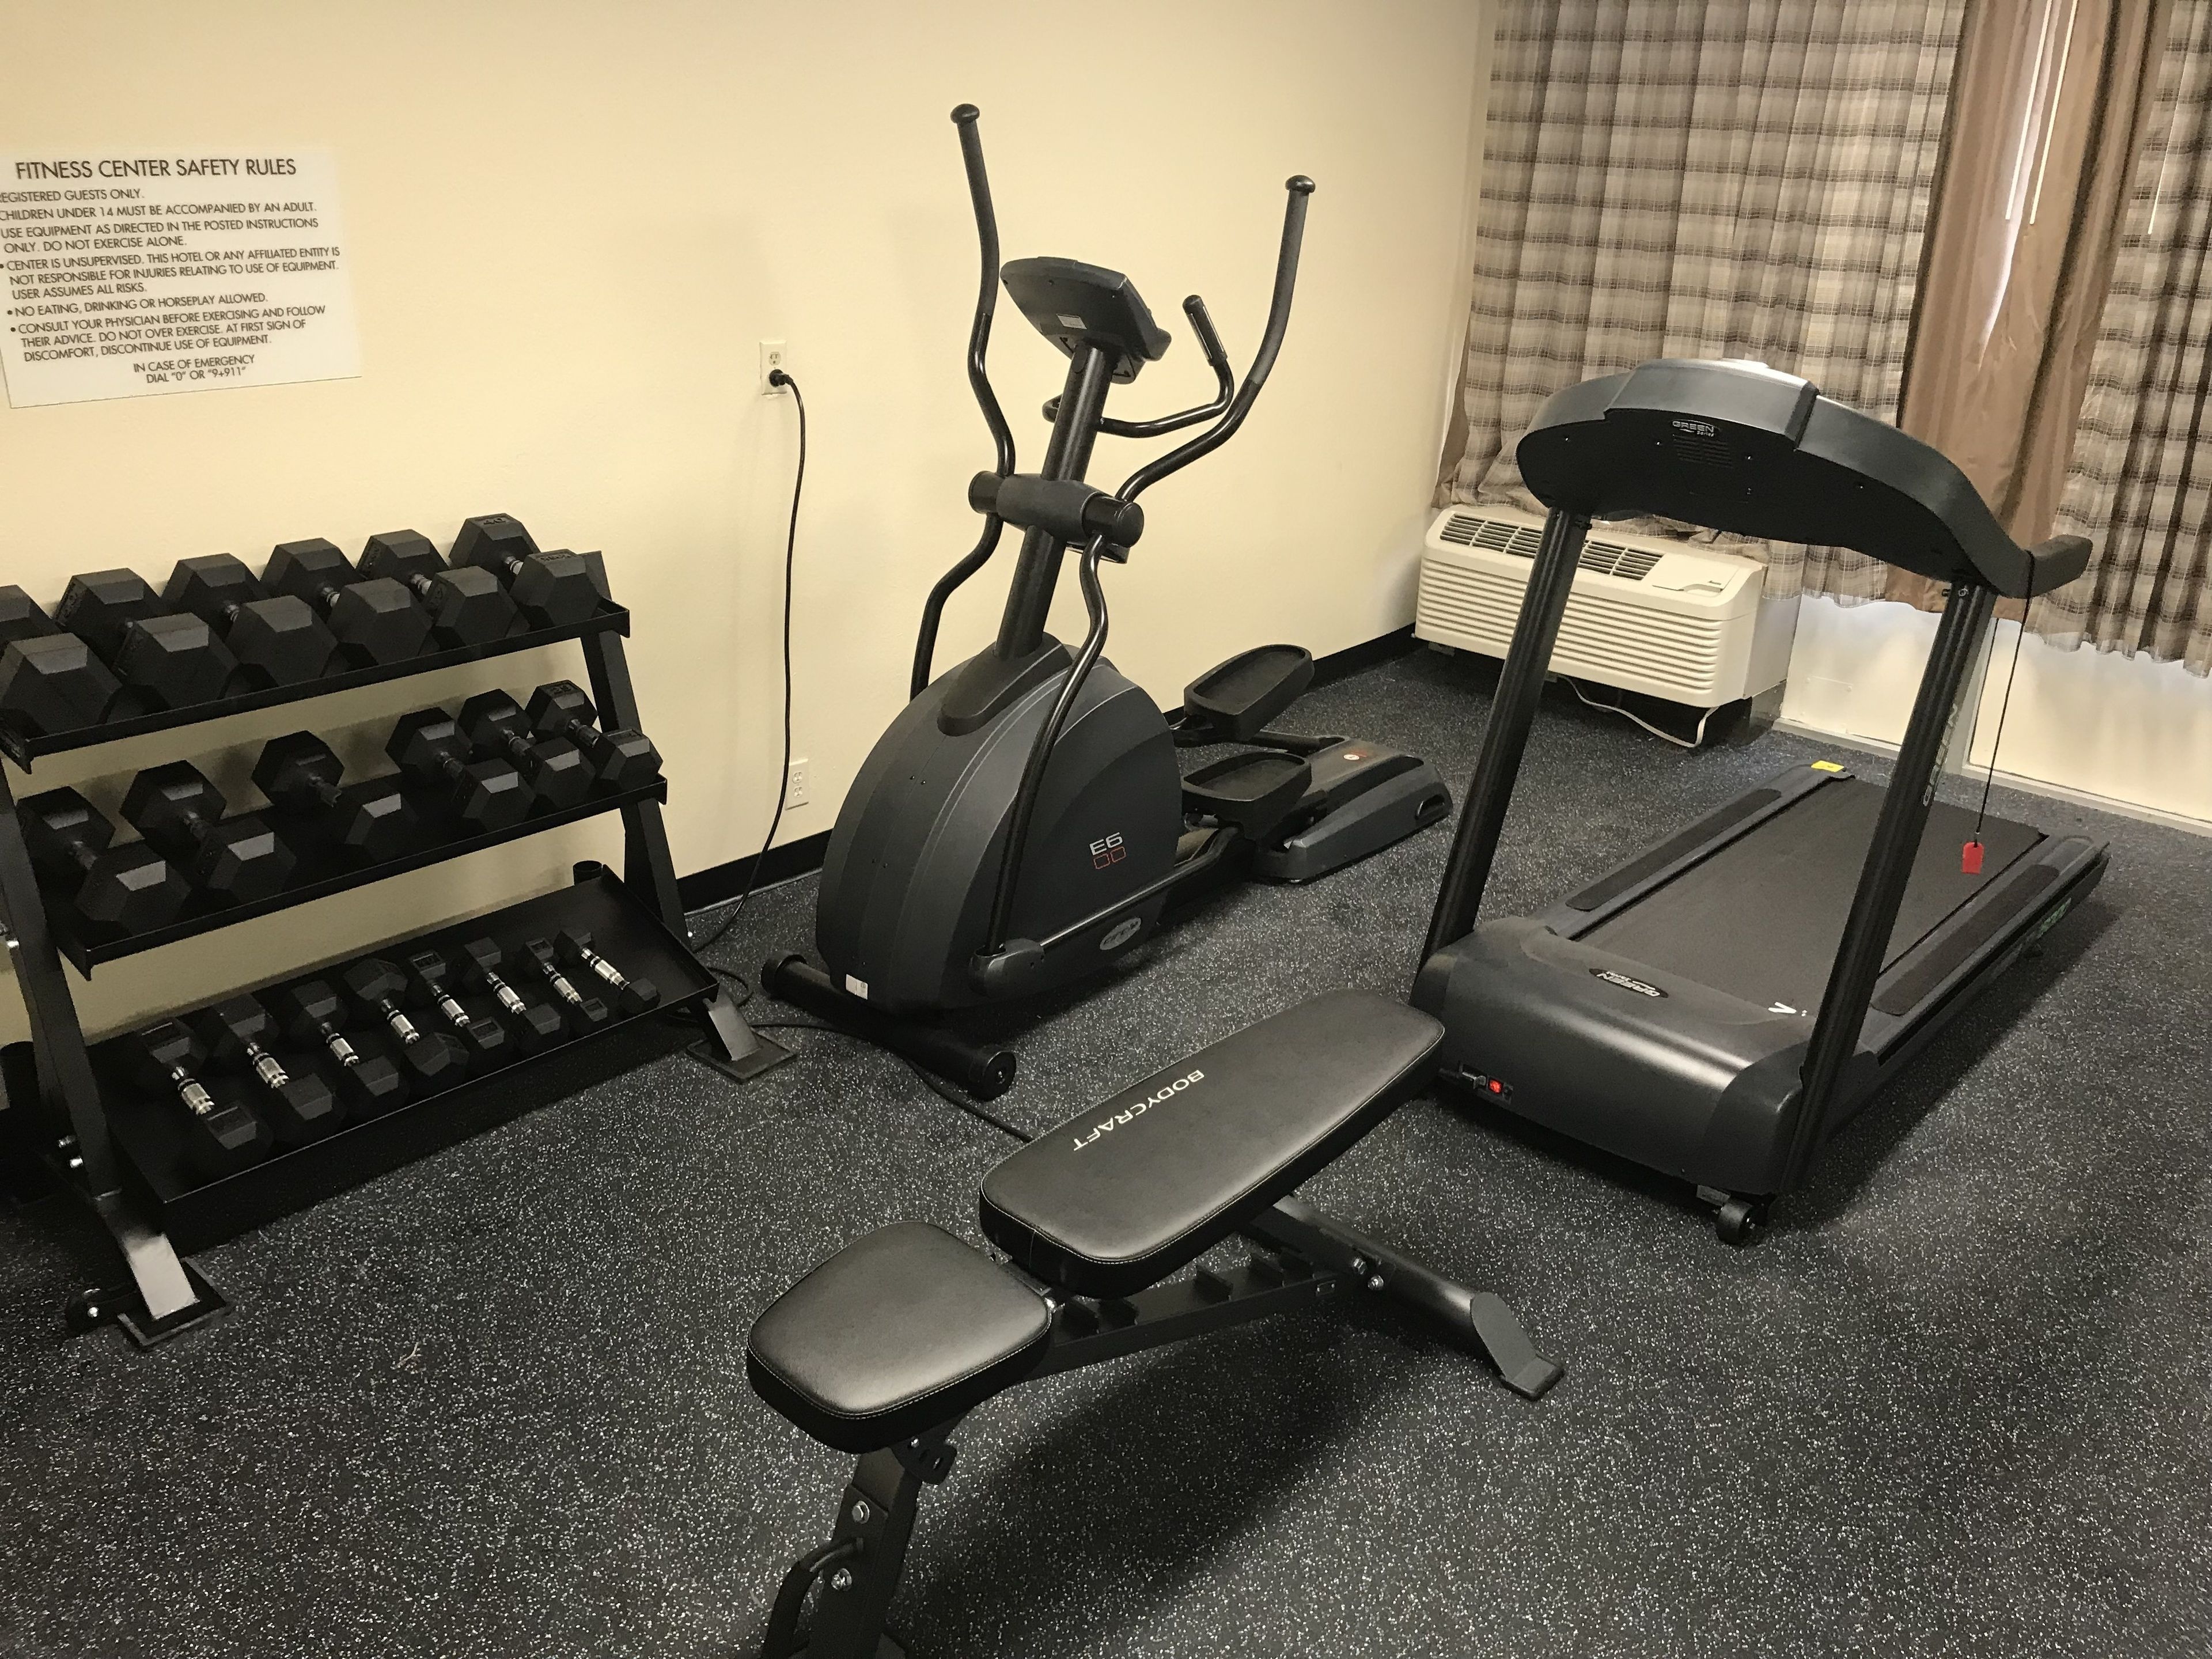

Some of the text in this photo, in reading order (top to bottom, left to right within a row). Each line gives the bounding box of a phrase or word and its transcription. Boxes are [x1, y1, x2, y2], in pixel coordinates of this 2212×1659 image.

[16, 158, 296, 179] FITNESS CENTER SAFETY RULES
[65, 190, 107, 200] GUESTS
[111, 188, 145, 199] ONLY.
[0, 202, 317, 221] CHILDREN UNDER 14 MUST BE ACCOMPANIED BY AN ADULT.
[1, 218, 319, 238] USE EQUIPMENT AS DIRECTED IN THE POSTED INSTRUCTIONS
[4, 236, 187, 253] ONLY. DO NOT EXERCISE ALONE.
[7, 247, 340, 271] CENTER IS UNSUPERVISED. THIS HOTEL OR ANY AFFILIATED ENTITY IS
[9, 275, 35, 286] NOT
[39, 271, 107, 284] RESPONSIBLE
[110, 270, 131, 280] FOR
[134, 267, 176, 279] INJURIES
[180, 265, 226, 276] RELATING
[229, 264, 243, 274] TO
[246, 263, 264, 273] USE
[266, 262, 280, 272] OF
[12, 282, 147, 300] USER ASSUMES ALL RISKS.
[16, 306, 35, 317] NO
[85, 300, 137, 312] DRINKING
[140, 298, 155, 309] OR
[158, 294, 215, 307] HORSEPLAY
[218, 293, 268, 304] ALLOWED.
[18, 305, 325, 334] CONSULT YOUR PHYSICIAN BEFORE EXERCISING AND FOLLOW
[21, 336, 51, 348] THEIR
[100, 331, 116, 342] DO
[120, 329, 142, 340] NOT
[145, 328, 173, 338] OVER
[226, 323, 238, 333] AT
[241, 321, 263, 332] FIRST
[267, 320, 290, 331] SIGN
[293, 319, 306, 329] OF
[24, 335, 271, 362] DISCOMFORT, DISCONTINUE USE OF EQUIPMENT.
[134, 354, 255, 373] IN CASE OF EMERGENCY
[146, 372, 169, 383] DIAL
[190, 369, 205, 380] OR
[1673, 421, 1714, 433] GREEN
[1089, 832, 1123, 855] E6
[1073, 1069, 1205, 1151] BODYCRAFT
